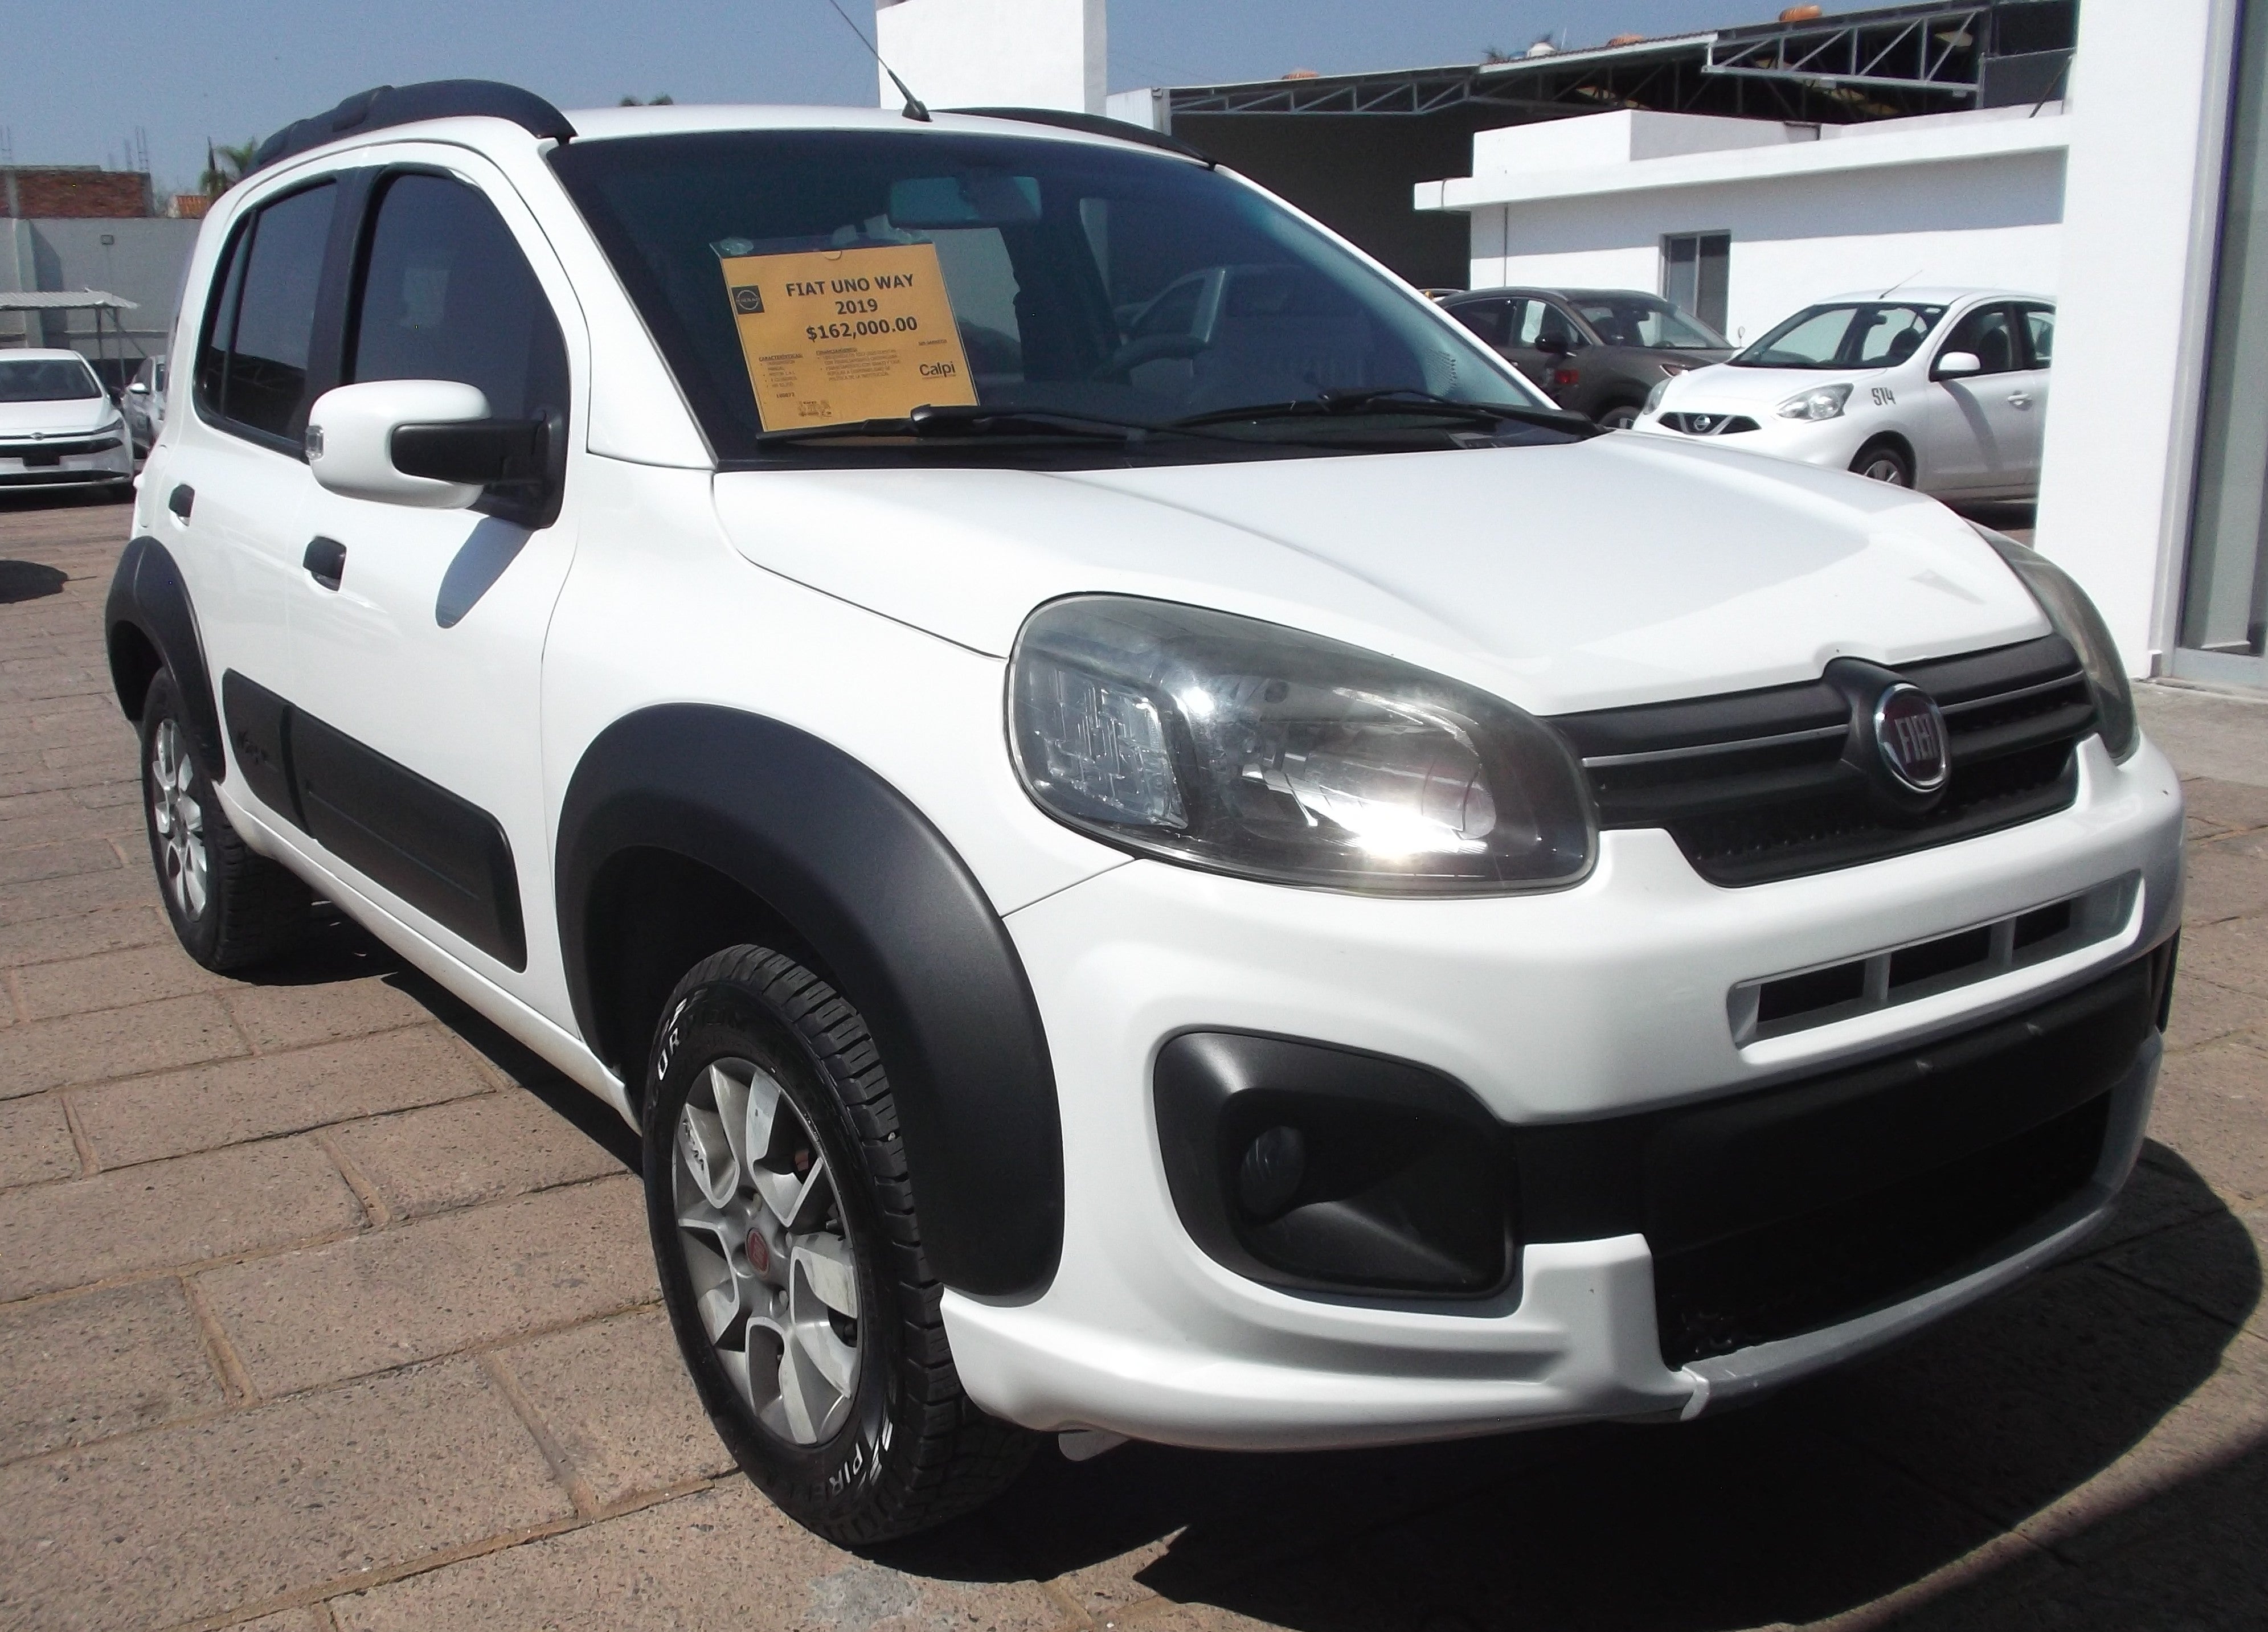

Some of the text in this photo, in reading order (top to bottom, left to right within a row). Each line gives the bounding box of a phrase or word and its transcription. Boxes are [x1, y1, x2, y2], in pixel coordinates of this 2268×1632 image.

[785, 274, 914, 297] FIAT UNO WAY
[835, 298, 878, 315] 2019
[806, 316, 918, 343] $162,000.00
[919, 361, 956, 378] Calpi
[1872, 387, 1896, 406] S14
[1894, 713, 1936, 764] FIAT
